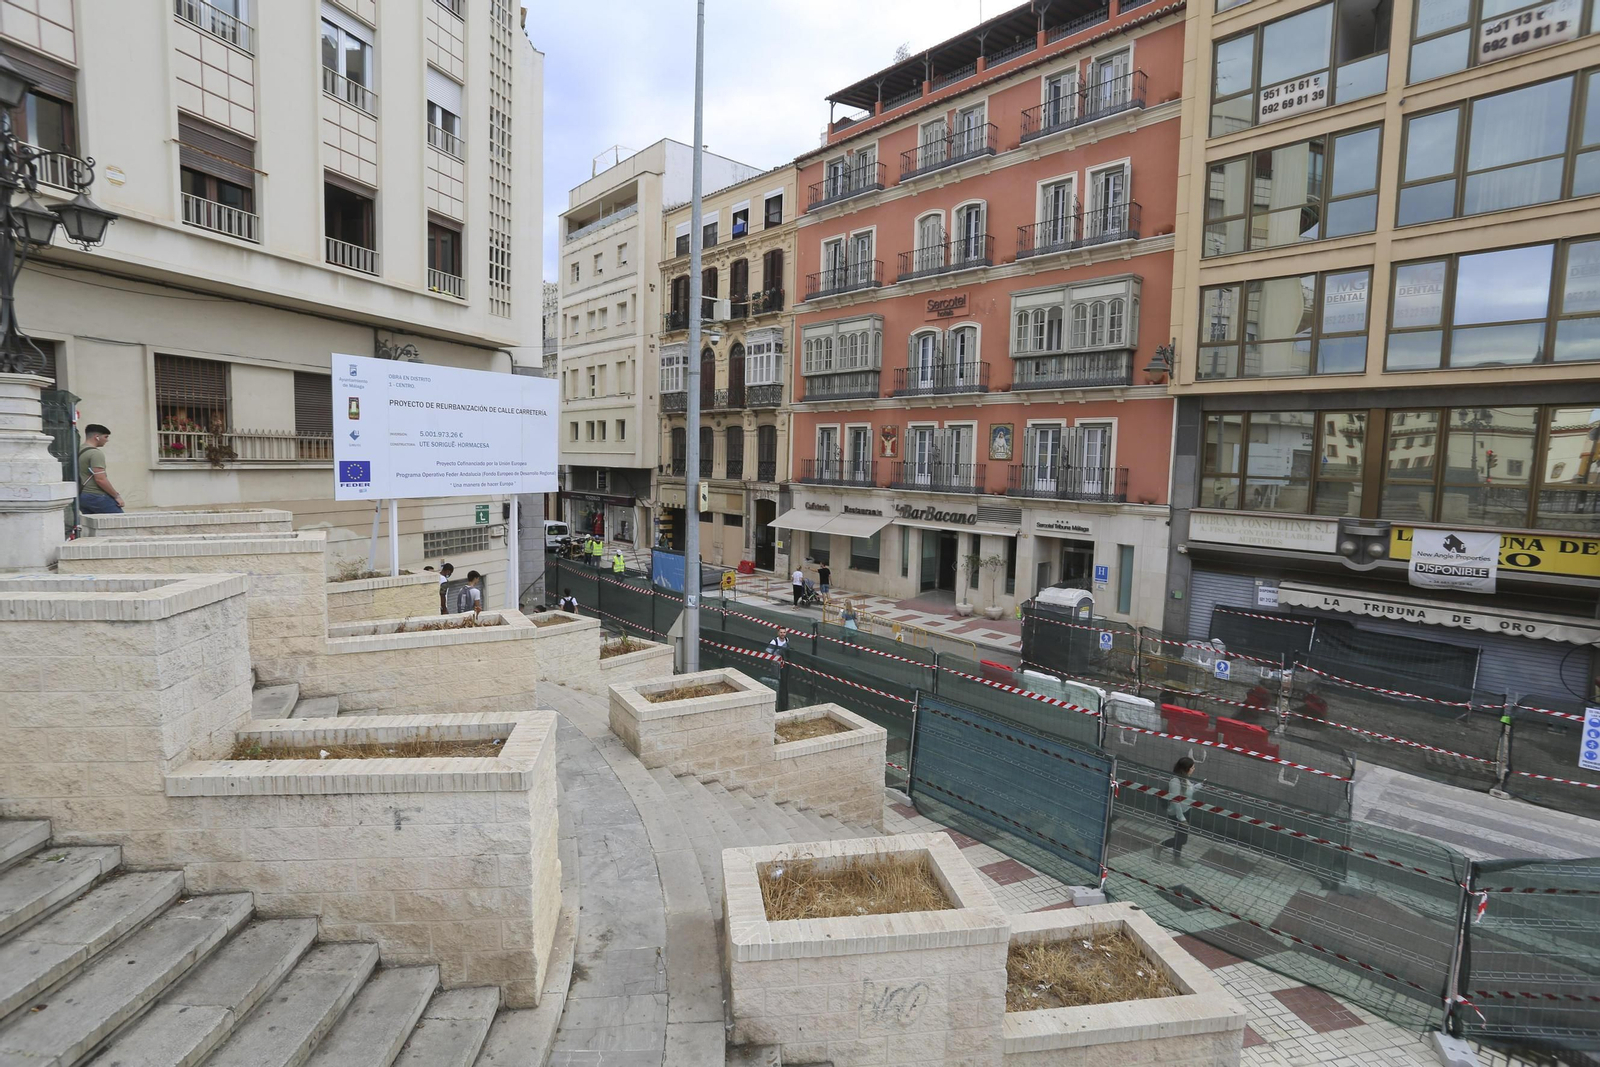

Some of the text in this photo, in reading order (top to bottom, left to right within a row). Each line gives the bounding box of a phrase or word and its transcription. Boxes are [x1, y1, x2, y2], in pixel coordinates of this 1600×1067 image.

[1515, 11, 1532, 27] 13
[1482, 36, 1508, 54] 692
[1511, 30, 1530, 46] 69
[1533, 24, 1551, 39] 81
[1263, 87, 1280, 101] 951
[1284, 83, 1295, 95] 13
[1298, 78, 1310, 91] 61
[1261, 89, 1325, 115] 692 69 81 39
[1337, 279, 1365, 293] MG
[1398, 284, 1441, 296] DENTAL
[927, 293, 966, 310] Sercotel
[1326, 292, 1364, 303] DENTAL
[389, 399, 424, 408] PROYECTO
[425, 401, 435, 409] DE
[436, 402, 488, 412] REURBANIZACIÓN
[498, 407, 515, 415] CALLE
[902, 504, 977, 526] BarBacana
[1054, 523, 1071, 531] Tribuna
[1071, 525, 1090, 533] Málaga
[1193, 514, 1336, 535] TRIBUNA CONSULTING S.L.
[1238, 536, 1283, 546] AUDITORES
[1558, 540, 1600, 556] DE
[1433, 552, 1454, 560] Angle
[1456, 553, 1491, 562] Properties
[1098, 567, 1105, 576] H
[1416, 563, 1487, 577] DISPONIBLE
[1324, 597, 1536, 633] LA TRIBUNA DE ORO
